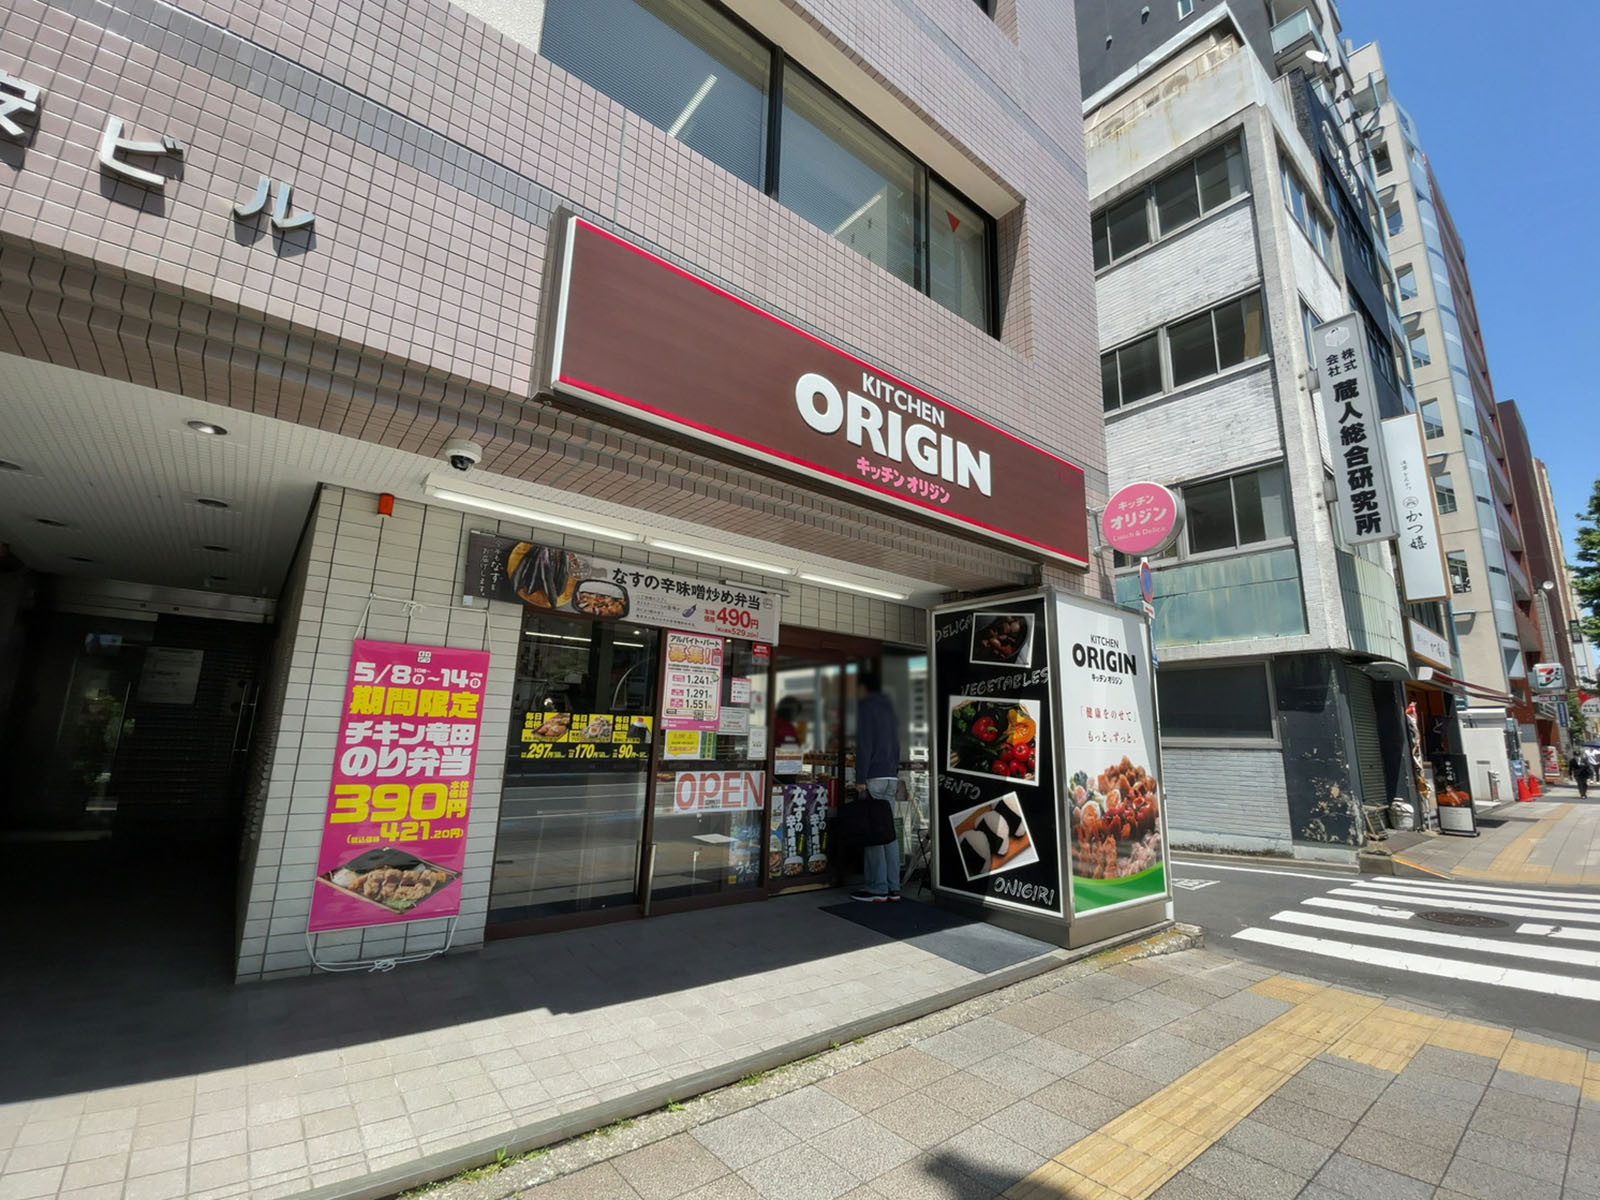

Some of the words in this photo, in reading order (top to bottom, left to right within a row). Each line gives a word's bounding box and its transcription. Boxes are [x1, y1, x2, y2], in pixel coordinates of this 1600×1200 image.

[861, 372, 946, 429] KITCHEN
[794, 372, 993, 498] ORIGIN
[1333, 376, 1382, 537] 蔵人総合研究所
[856, 456, 905, 487] キッチン
[906, 476, 951, 504] オリジン
[1110, 506, 1168, 531] オリジン
[1118, 495, 1155, 511] キッチン
[612, 567, 762, 611] なすの辛味噌炒め弁当
[716, 607, 759, 630] 490円
[1090, 634, 1120, 649] KITCHEN
[1072, 642, 1137, 676] ORIGIN
[960, 666, 1050, 697] VEGETABLES
[349, 684, 480, 719] 期間限定
[345, 720, 477, 747] チキン竜田
[340, 745, 473, 778] のり弁当
[676, 773, 764, 810] OPEN
[993, 876, 1055, 906] ONIGIRI
